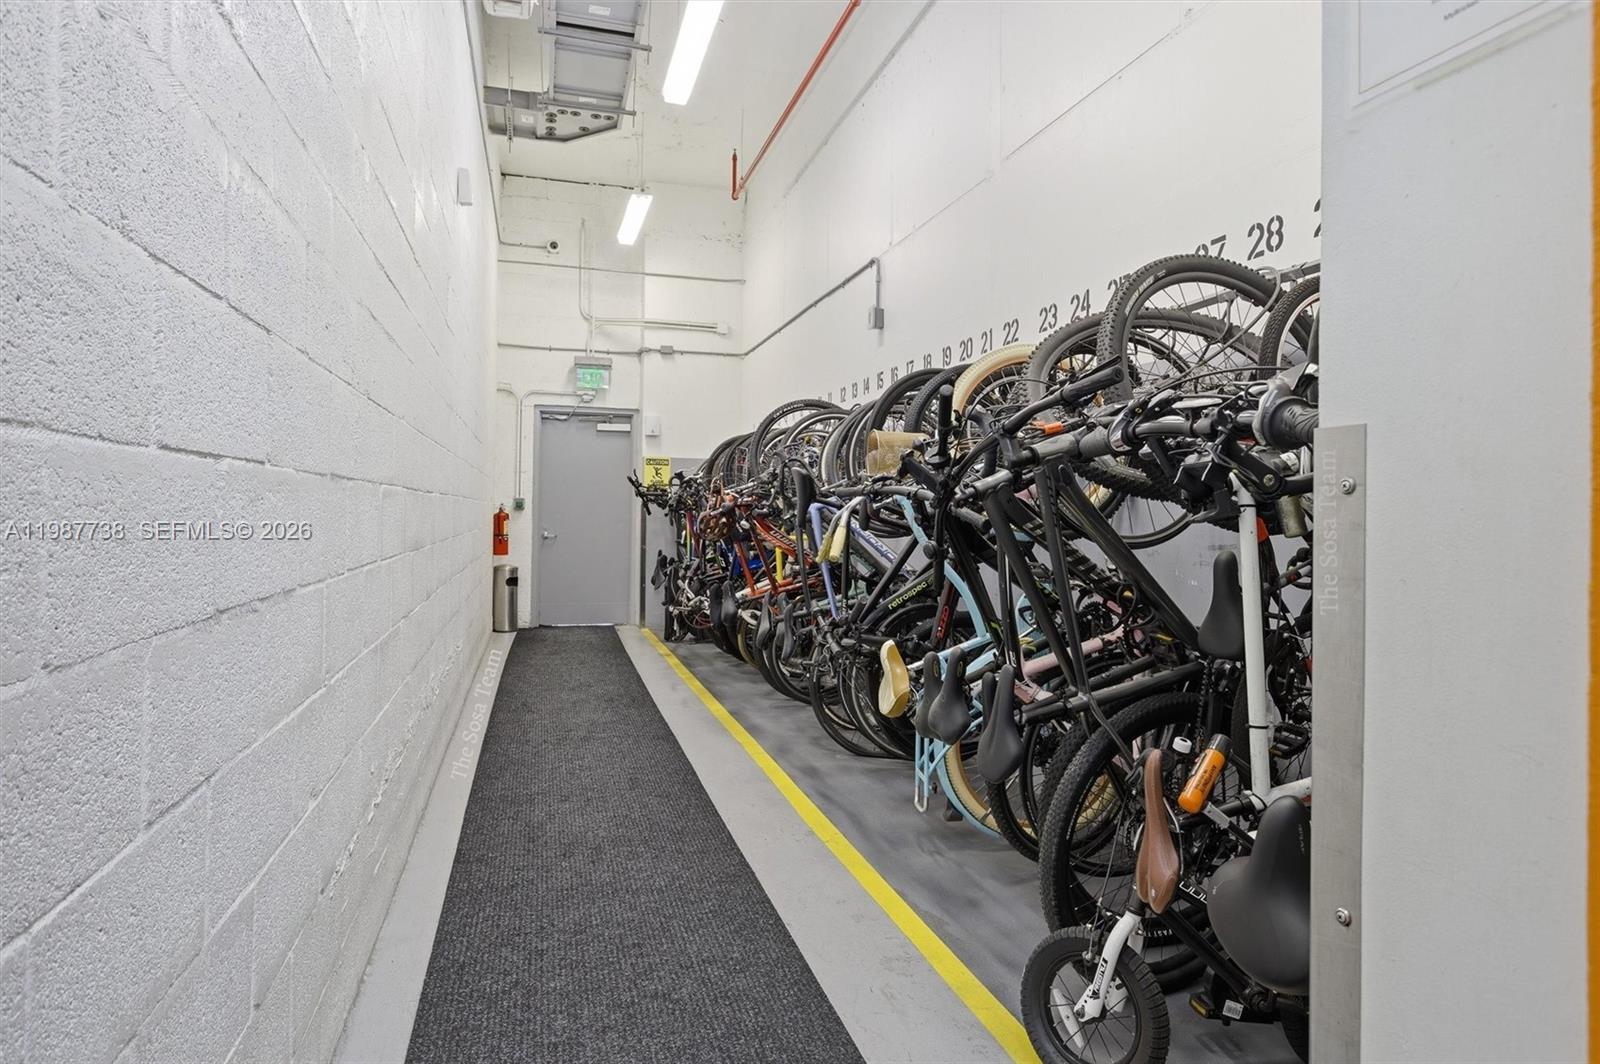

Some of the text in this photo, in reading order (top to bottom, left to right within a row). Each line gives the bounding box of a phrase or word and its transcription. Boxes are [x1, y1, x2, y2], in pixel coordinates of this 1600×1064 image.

[1246, 214, 1284, 261] 28
[1069, 288, 1091, 323] 24
[1039, 303, 1058, 333] 23
[981, 328, 993, 355] 21
[1003, 318, 1020, 346] 22
[923, 353, 932, 369] 18
[942, 345, 952, 368] 19
[959, 337, 974, 362] 20
[890, 366, 899, 385] 16
[906, 360, 915, 375] 17
[852, 382, 858, 400] 13
[863, 377, 870, 395] 14
[877, 371, 884, 391] 15
[840, 386, 847, 403] 12
[888, 581, 928, 610] retrospec
